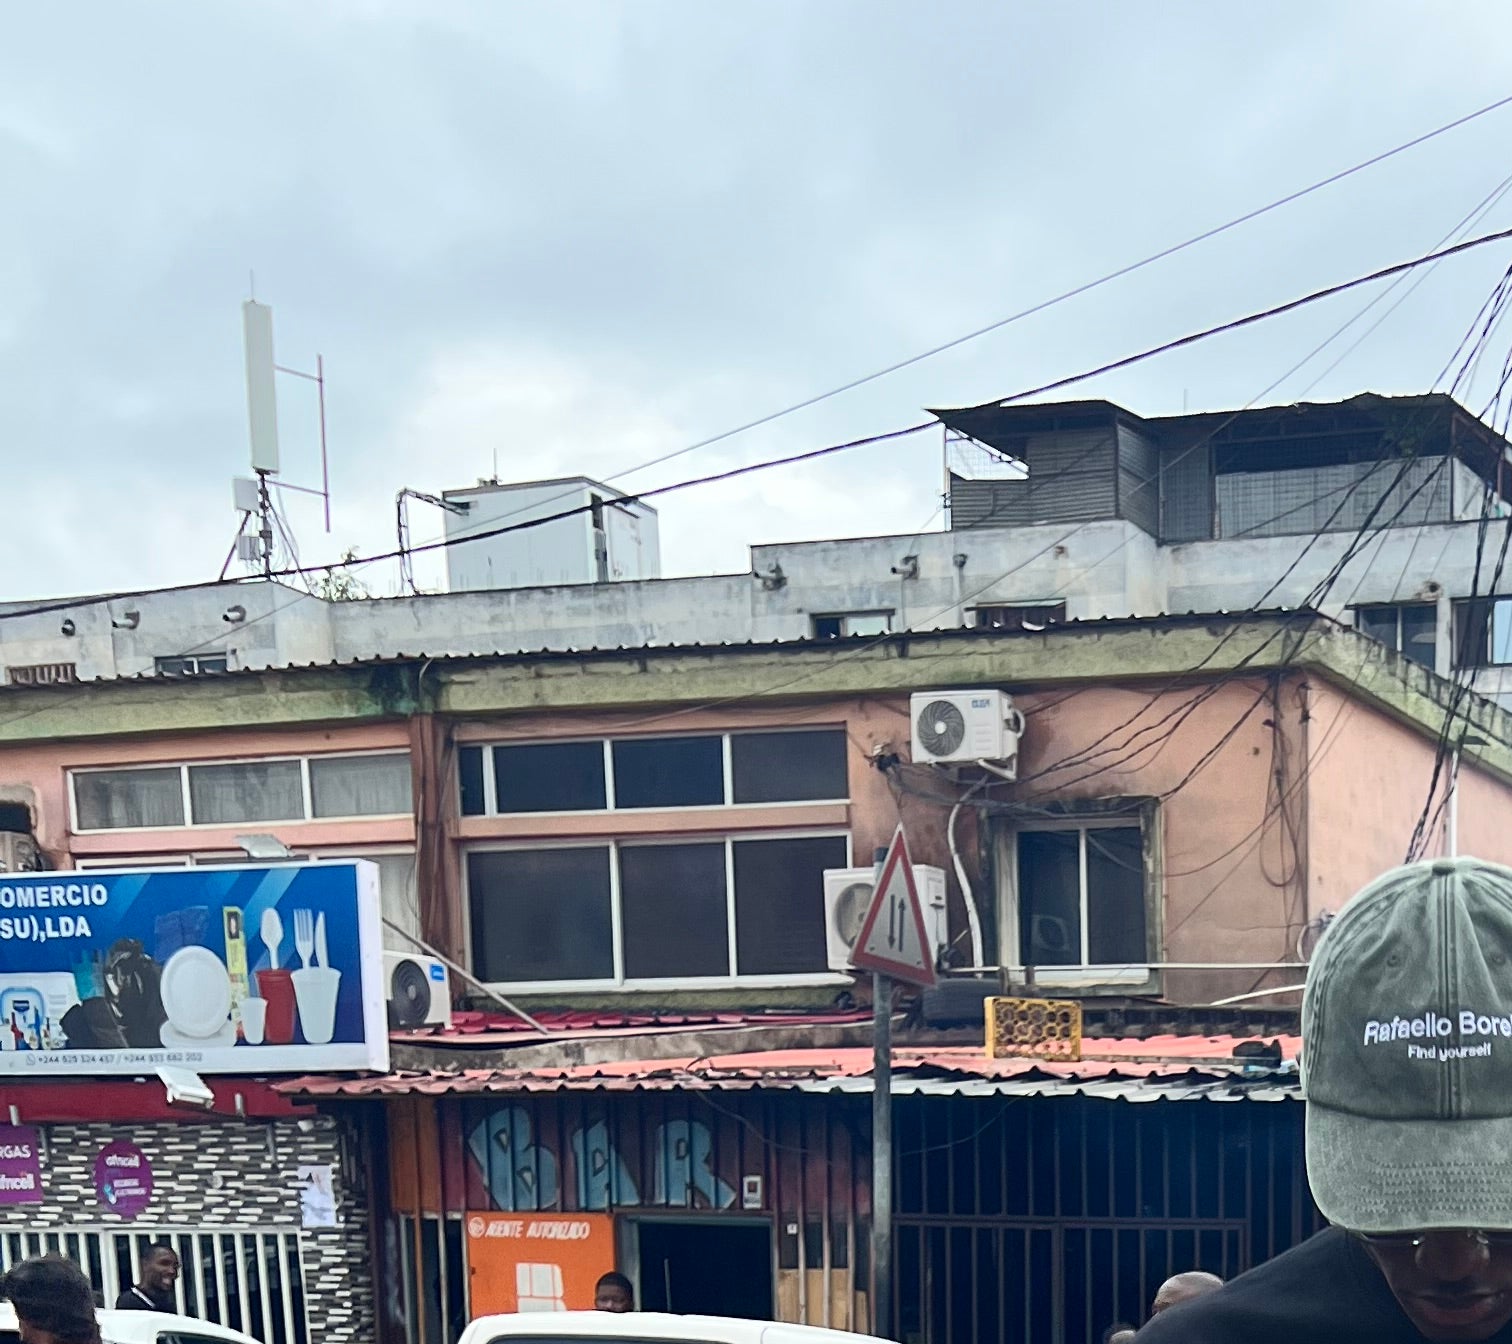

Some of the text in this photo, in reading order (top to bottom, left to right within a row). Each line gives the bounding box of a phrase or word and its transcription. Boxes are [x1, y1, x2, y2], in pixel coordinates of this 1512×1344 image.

[0, 883, 108, 909] OMERCIO
[1363, 1012, 1453, 1046] Rafaello
[1407, 1042, 1492, 1062] Find yourself
[467, 1104, 738, 1213] BAR
